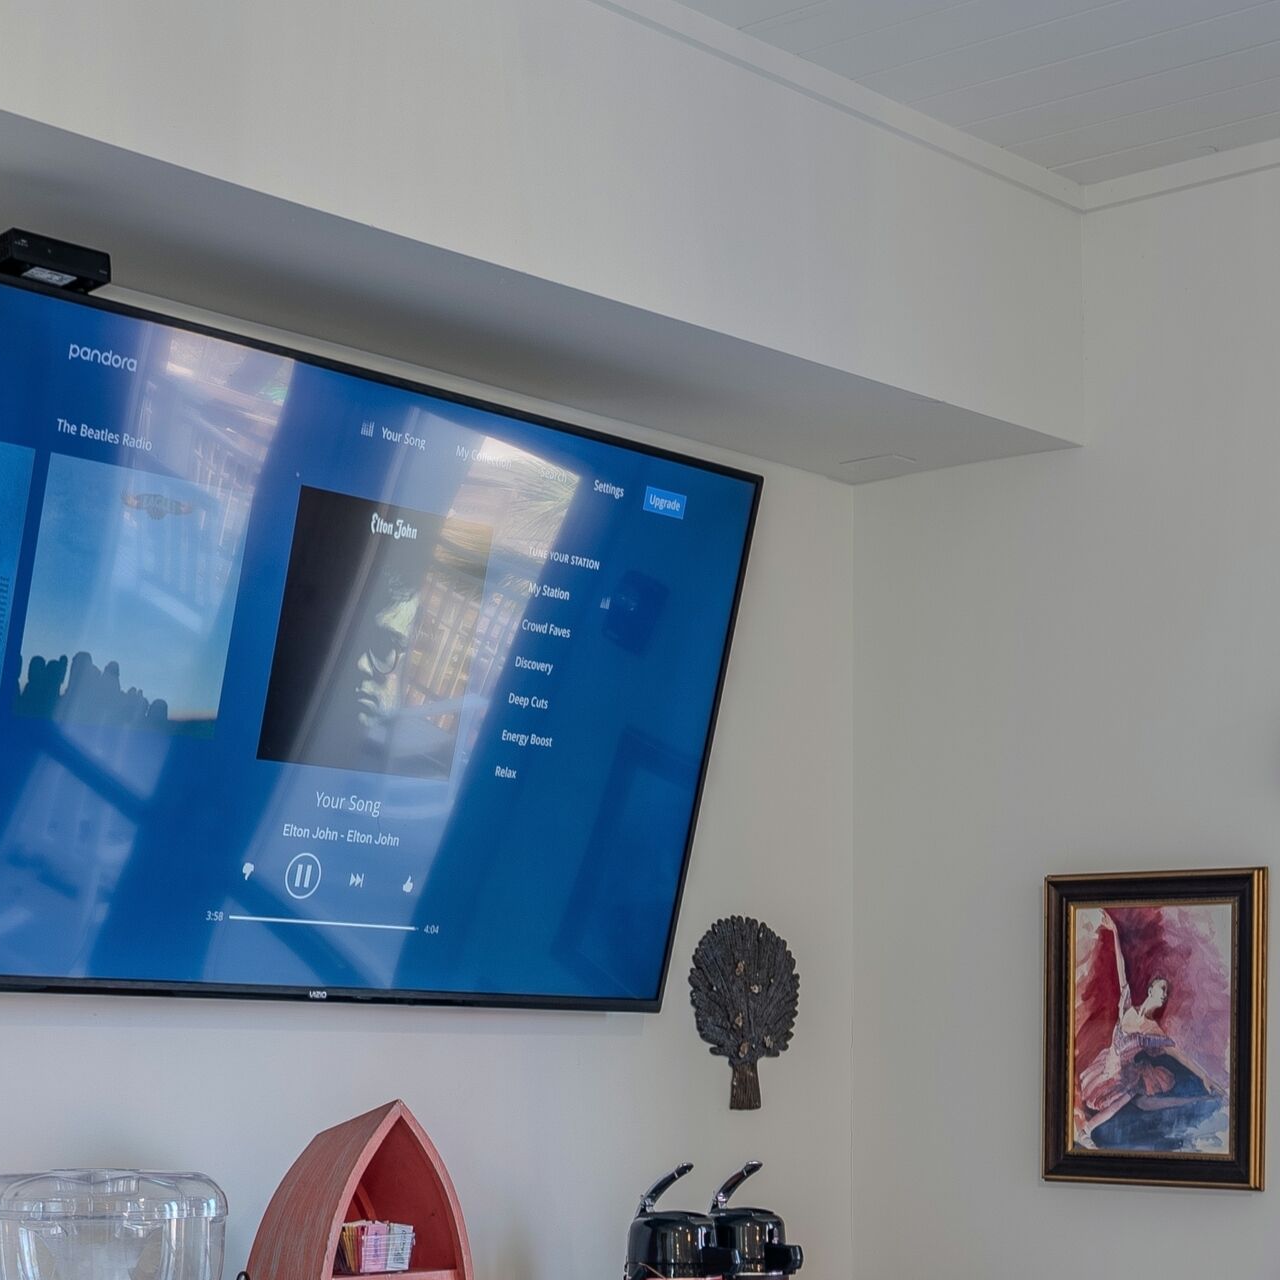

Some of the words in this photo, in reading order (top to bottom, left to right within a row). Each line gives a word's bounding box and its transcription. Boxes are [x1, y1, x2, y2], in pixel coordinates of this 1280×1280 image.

[68, 343, 138, 373] pandora
[57, 418, 77, 436] The
[80, 423, 120, 445] Beatles
[122, 433, 152, 452] Radio
[381, 426, 403, 443] Your
[403, 432, 427, 451] Song
[455, 445, 470, 462] My
[471, 449, 512, 470] Collection
[593, 479, 625, 500] Settings
[649, 493, 681, 512] Upgrade
[371, 512, 393, 536] Elton
[394, 519, 418, 540] John
[528, 545, 548, 559] TUNE
[550, 551, 569, 565] YOUR
[570, 554, 600, 571] STATION
[528, 581, 541, 597] My
[542, 584, 570, 601] Station
[521, 618, 548, 635] Crowd
[549, 623, 571, 639] Faves
[514, 655, 554, 676] Discovery
[508, 692, 530, 709] Deep
[531, 695, 549, 710] Cuts
[501, 728, 529, 746] Energy
[530, 733, 553, 748] Boost
[494, 765, 517, 780] Relax
[316, 791, 345, 810] Your
[348, 794, 381, 818] Song
[282, 823, 310, 840] Elton
[312, 826, 338, 841] John
[346, 829, 373, 845] Elton
[374, 832, 400, 848] John
[423, 924, 440, 935] 4:04
[309, 990, 327, 999] VIZIO
